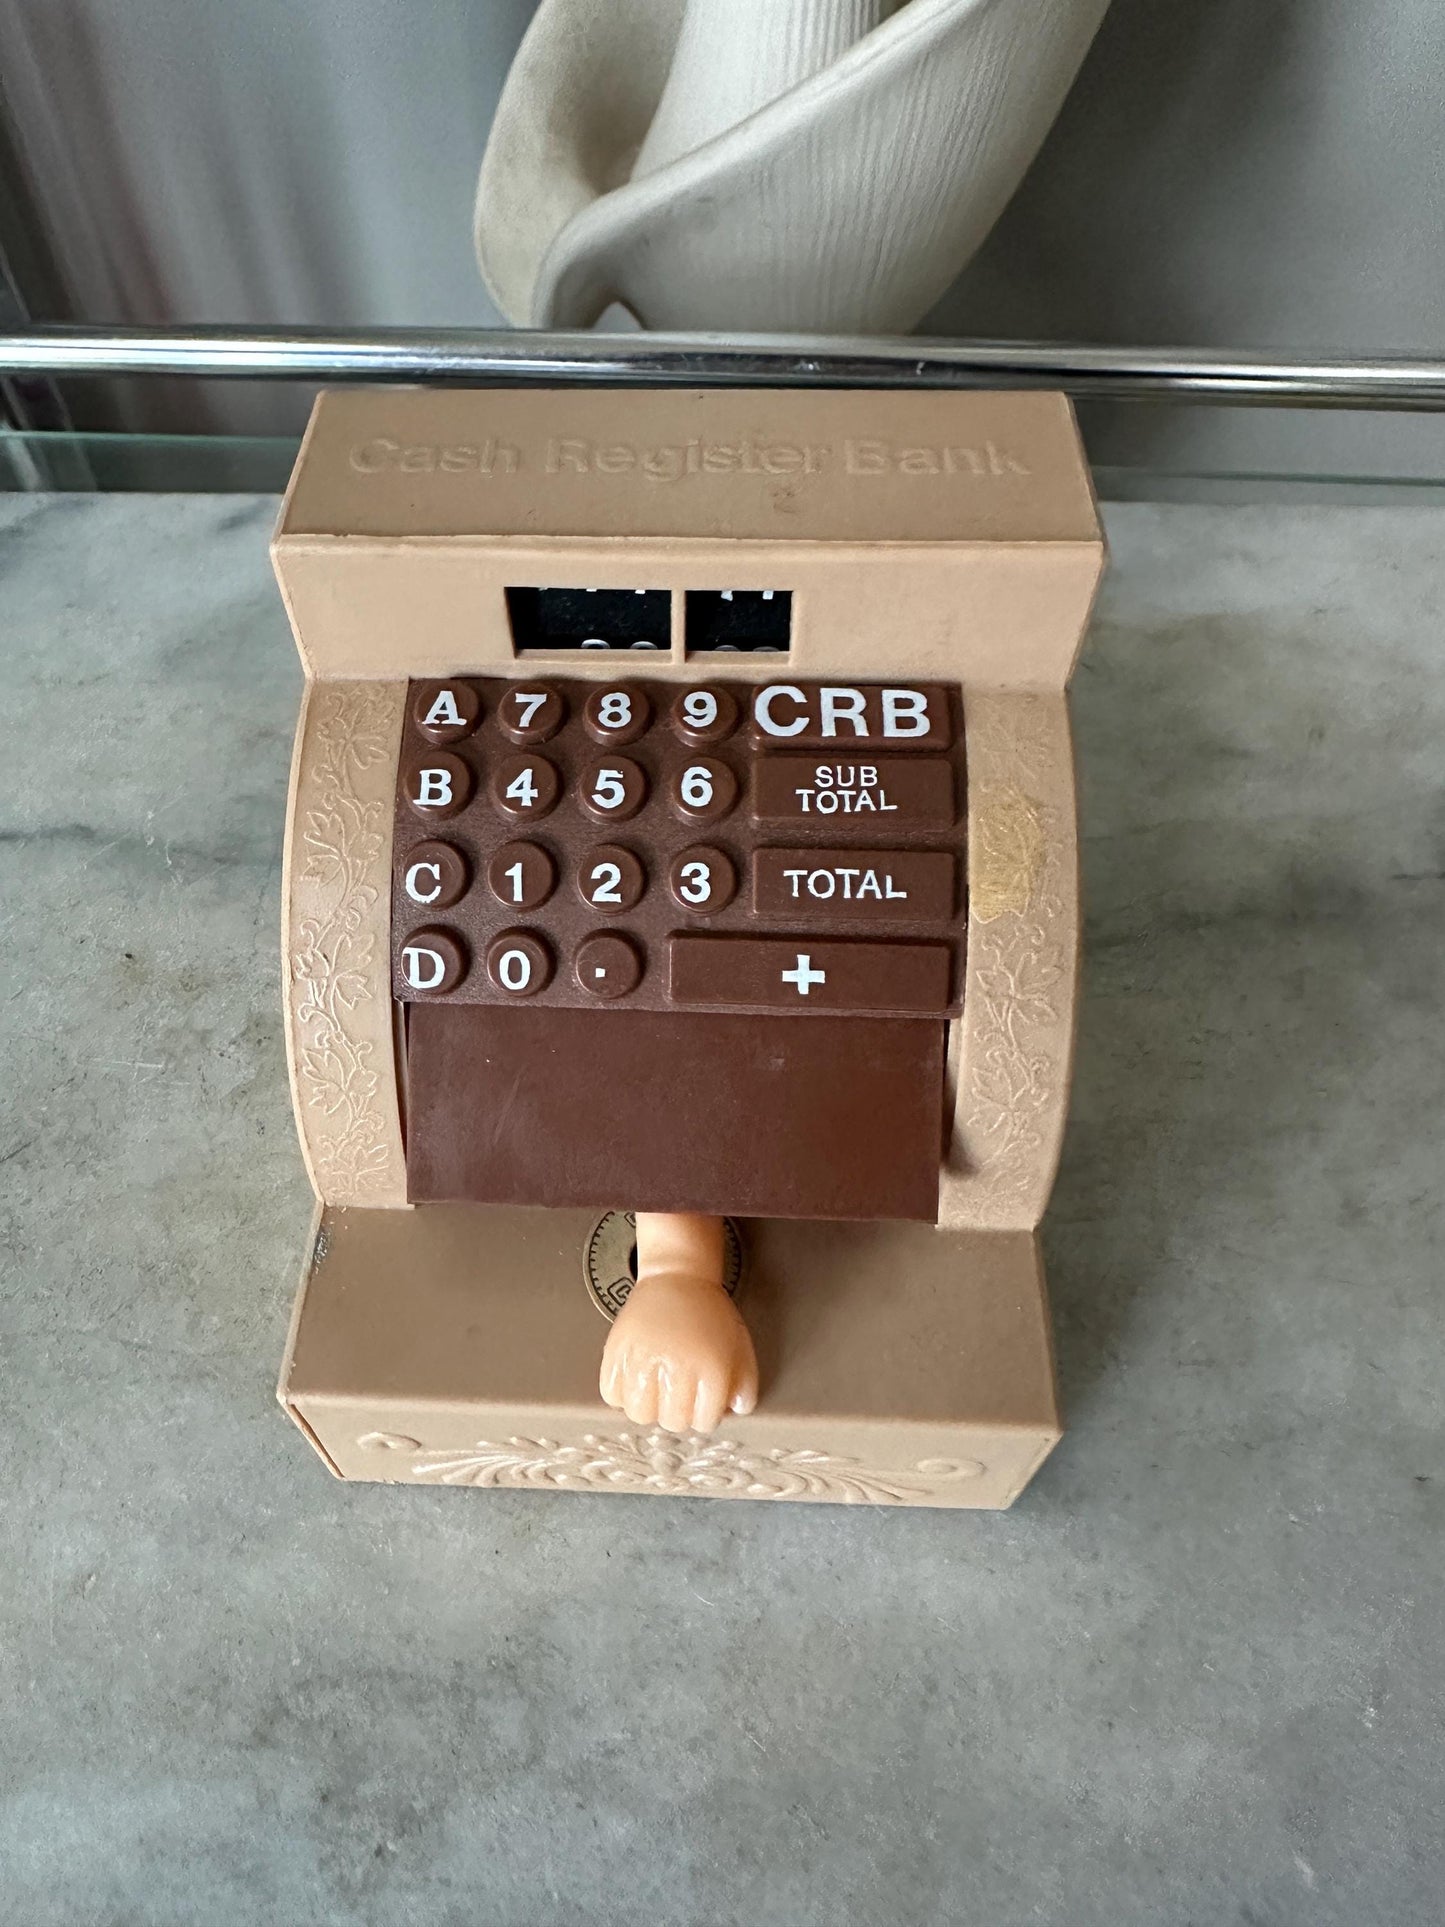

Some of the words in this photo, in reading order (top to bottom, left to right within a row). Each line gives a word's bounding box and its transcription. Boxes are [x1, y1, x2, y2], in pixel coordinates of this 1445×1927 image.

[348, 438, 520, 474] Cash
[546, 438, 832, 481] Register
[845, 439, 1032, 476] Bank
[422, 691, 467, 726] A
[515, 693, 547, 728] 7
[598, 692, 632, 728] 8
[683, 691, 718, 728] 9
[755, 686, 931, 738] CRB
[413, 769, 453, 806] B
[506, 769, 539, 807] 4
[591, 769, 626, 809] 5
[681, 766, 713, 807] 6
[814, 765, 878, 788] SUB
[796, 788, 898, 815] TOTAL
[405, 862, 442, 904] C
[504, 862, 523, 902] 1
[590, 862, 622, 903] 2
[679, 862, 711, 904] 3
[783, 869, 907, 900] TOTAL
[401, 947, 446, 990] D
